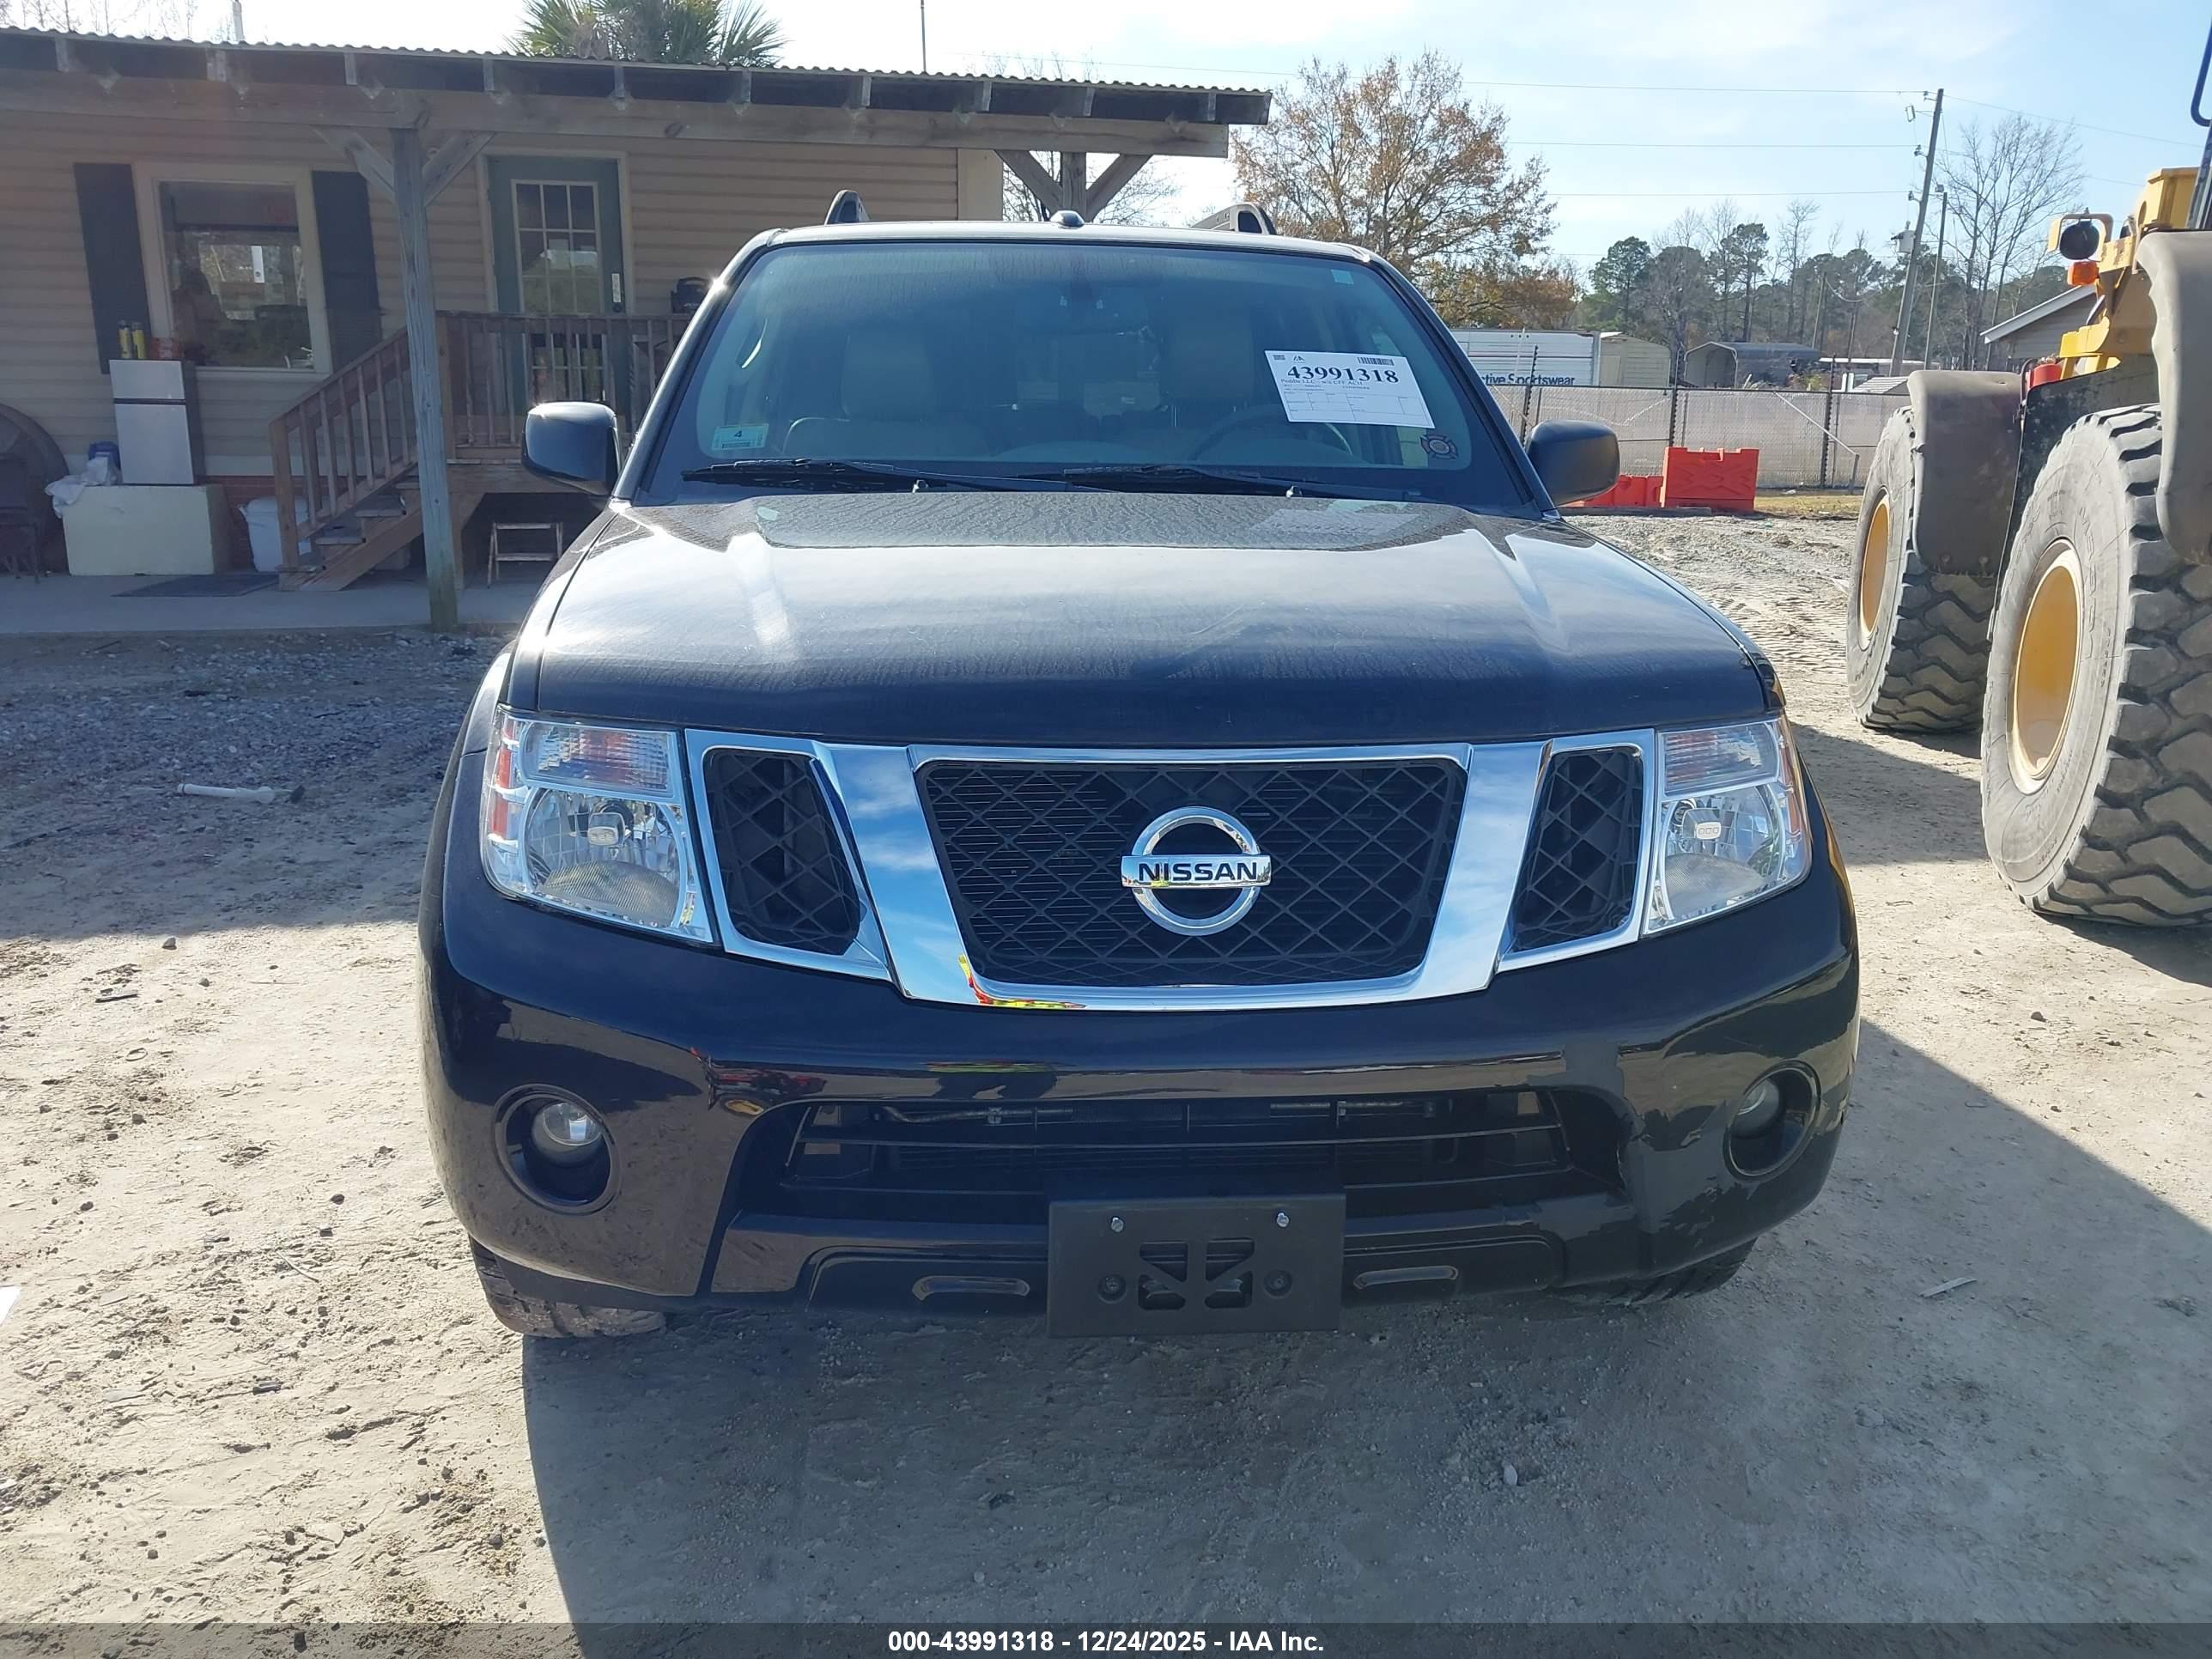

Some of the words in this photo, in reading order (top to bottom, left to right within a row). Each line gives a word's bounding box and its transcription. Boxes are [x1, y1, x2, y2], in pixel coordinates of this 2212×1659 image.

[1287, 366, 1399, 384] 43991318
[1480, 373, 1506, 385] tive
[1508, 373, 1576, 386] Sportswear
[734, 429, 743, 438] 4
[1139, 862, 1257, 881] NISSAN
